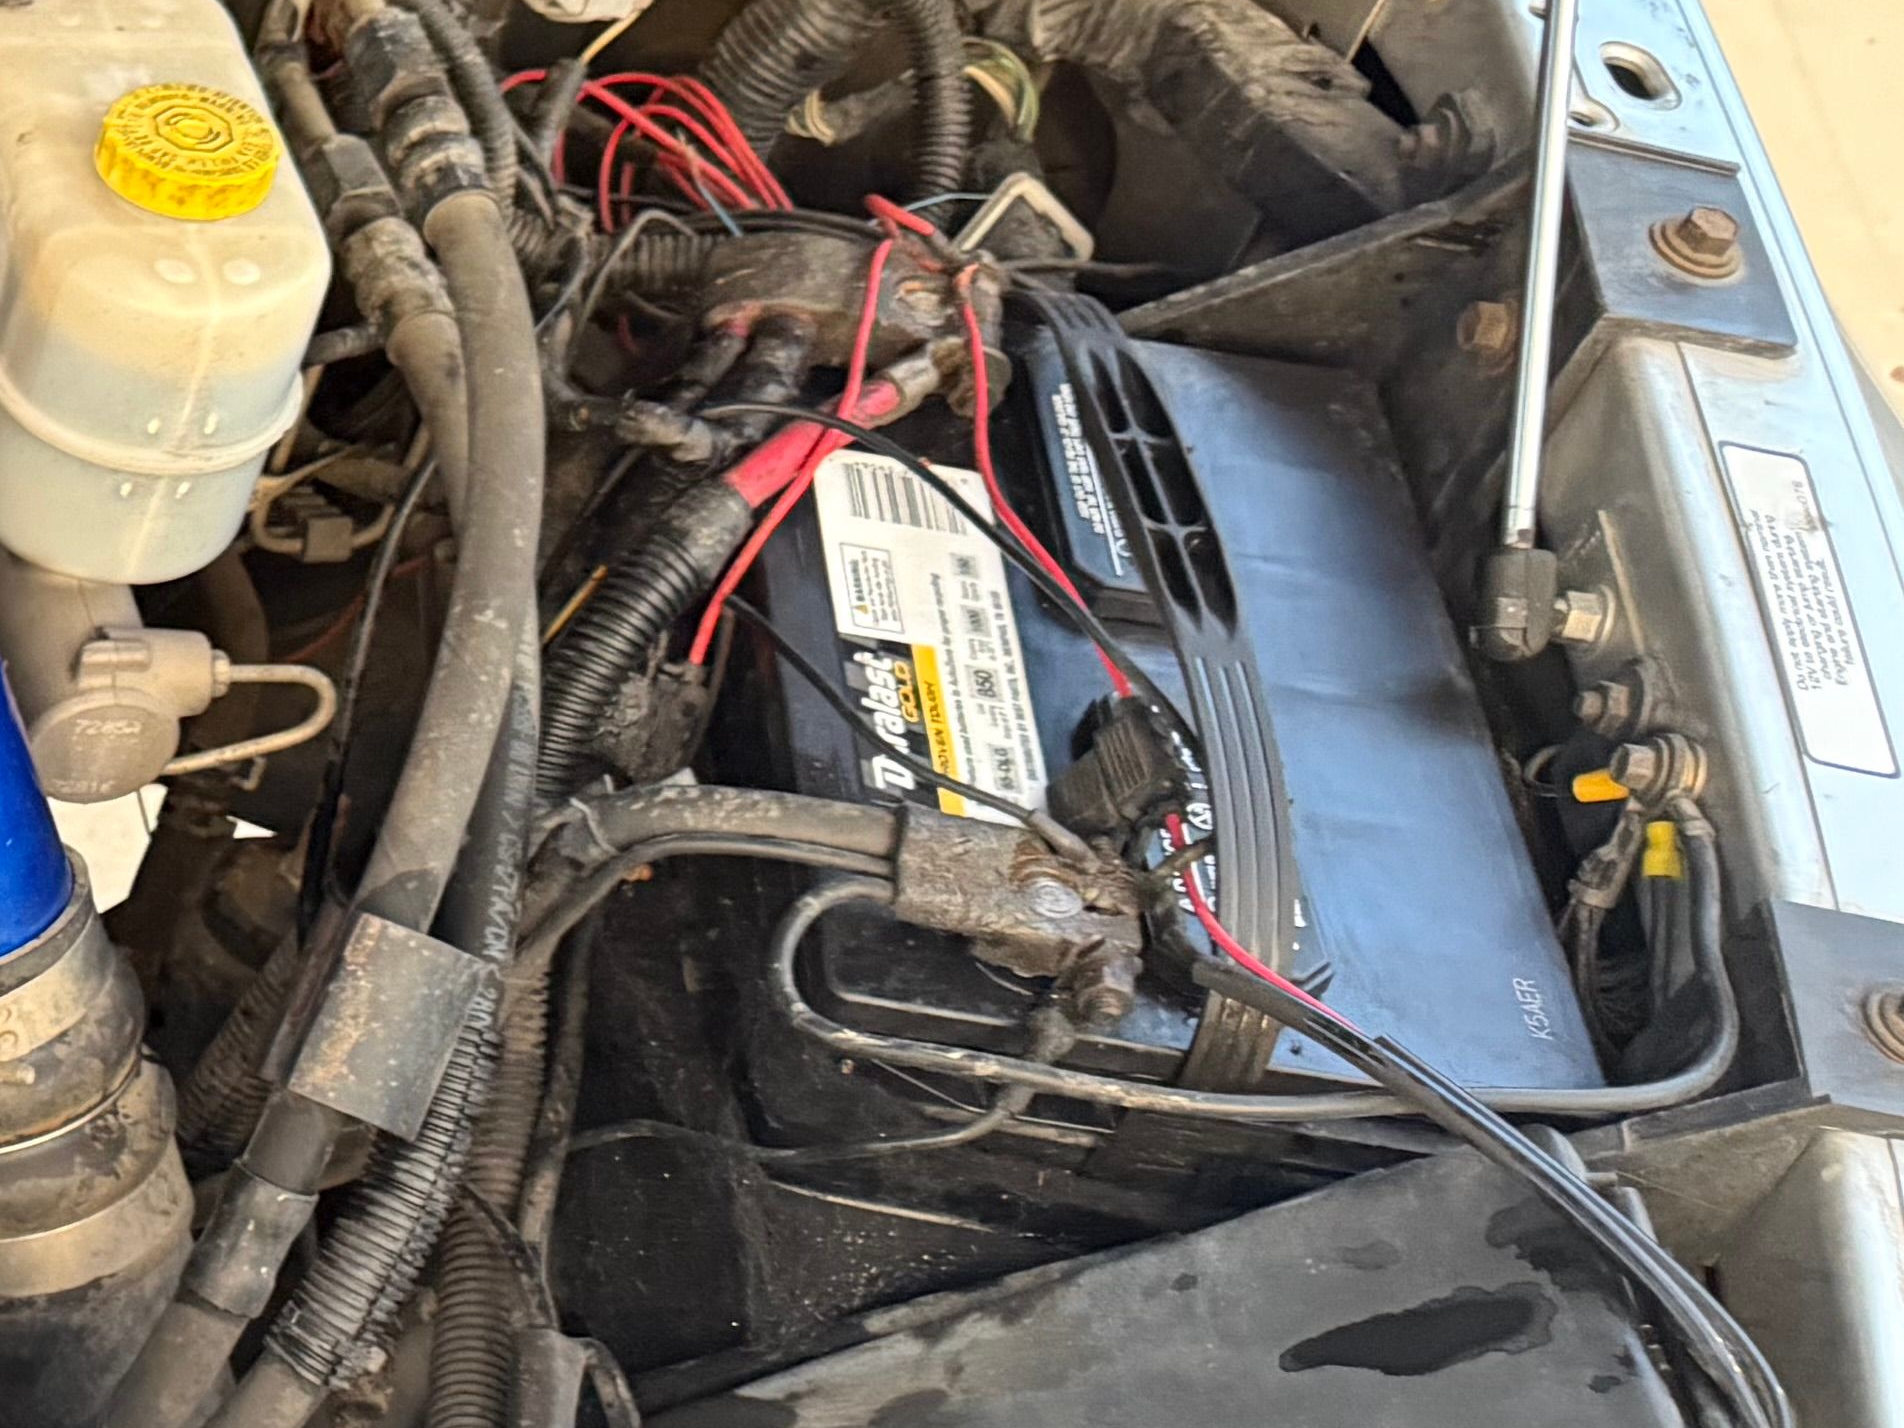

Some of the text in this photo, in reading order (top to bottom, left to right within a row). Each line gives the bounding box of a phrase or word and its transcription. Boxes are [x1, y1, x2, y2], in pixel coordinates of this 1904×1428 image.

[893, 659, 920, 723] GOLD
[972, 668, 997, 698] 850
[852, 647, 917, 795] Dralast
[1513, 978, 1555, 1040] K5AER
